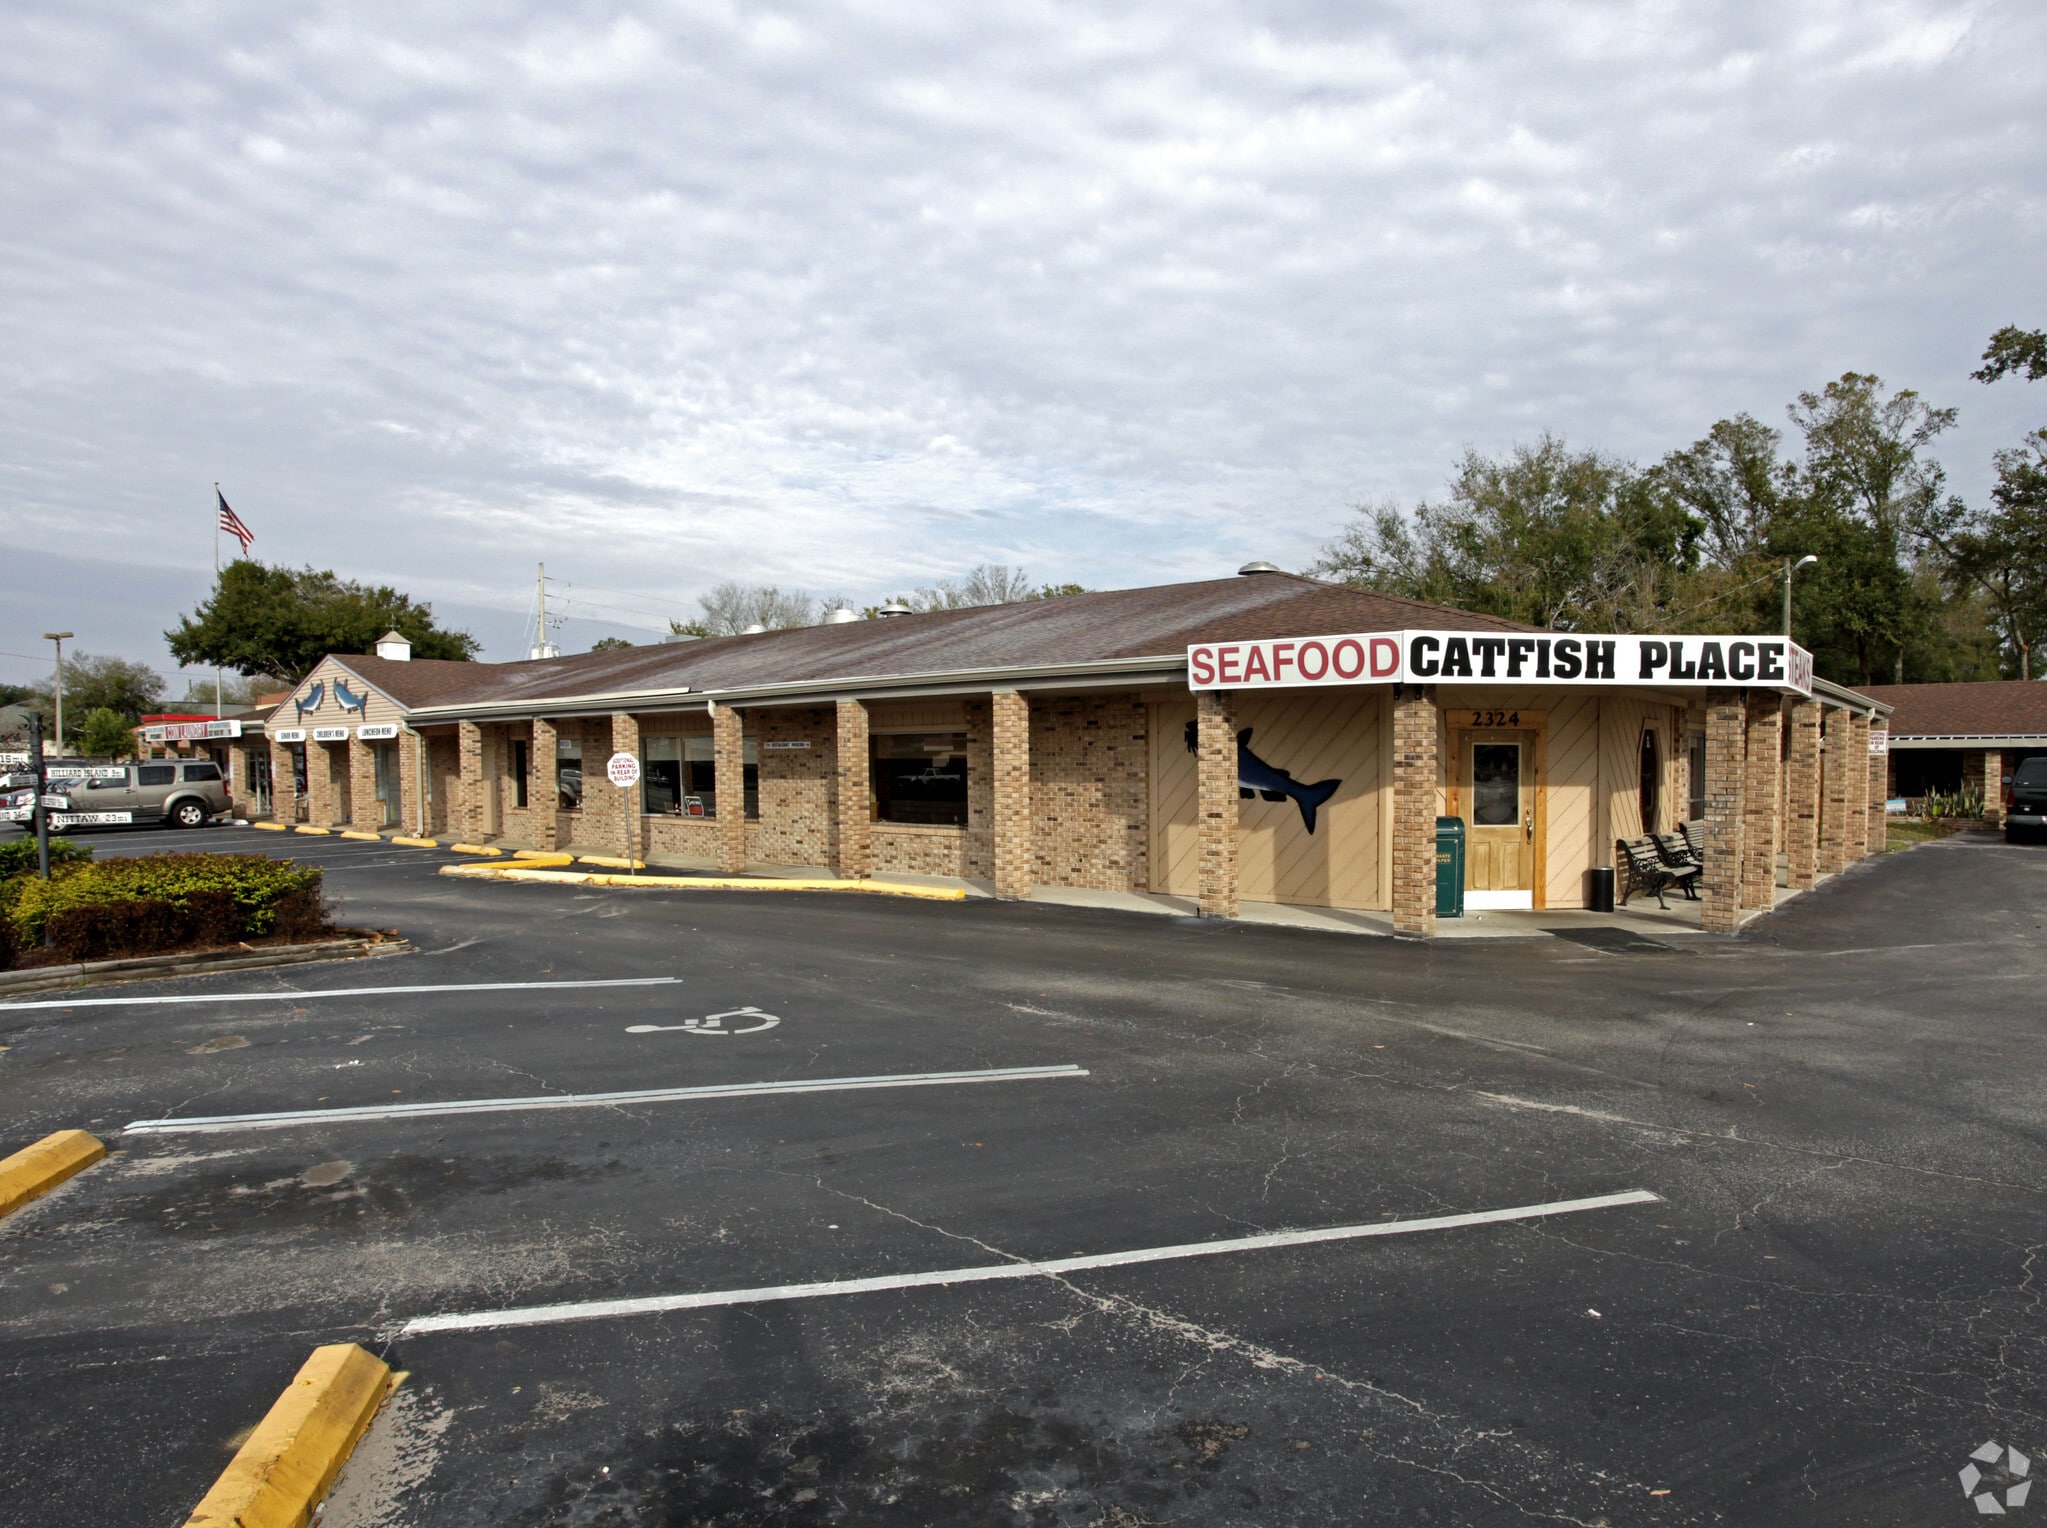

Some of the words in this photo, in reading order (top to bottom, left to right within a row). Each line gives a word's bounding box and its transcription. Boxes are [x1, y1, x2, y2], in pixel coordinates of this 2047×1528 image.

[1191, 638, 1400, 685] SEAFOOD
[1410, 636, 1615, 679] CATFISH
[1639, 641, 1784, 680] PLACE
[1472, 711, 1519, 727] 2324
[166, 726, 179, 739] COIN
[181, 724, 207, 738] LAUNDRY
[381, 727, 392, 735] MENU
[84, 769, 108, 777] ISLAND
